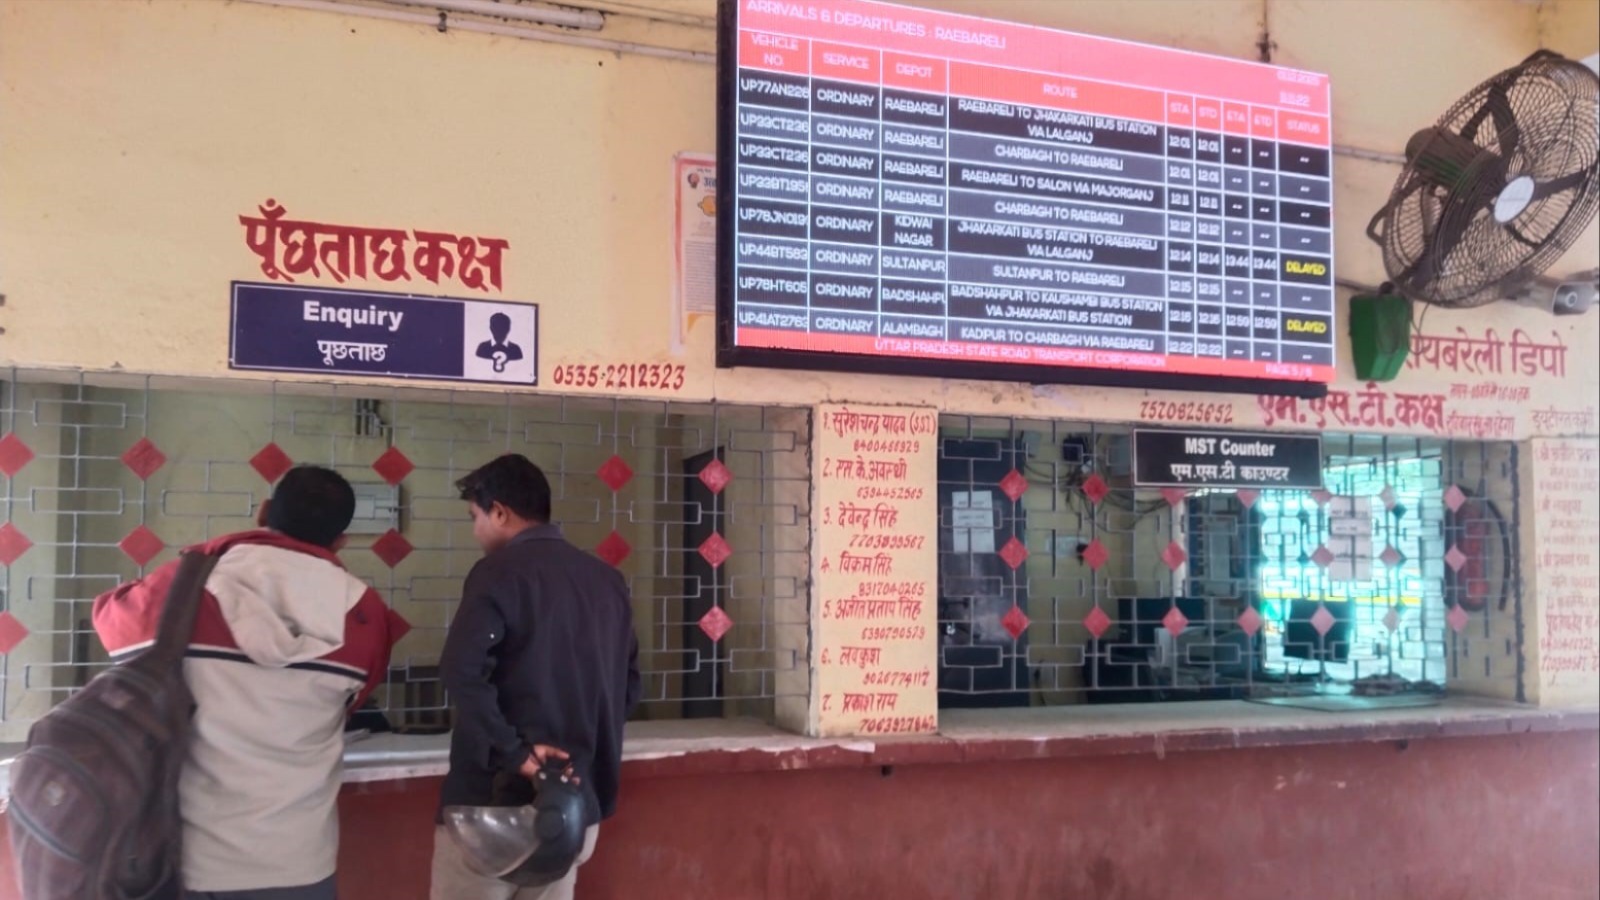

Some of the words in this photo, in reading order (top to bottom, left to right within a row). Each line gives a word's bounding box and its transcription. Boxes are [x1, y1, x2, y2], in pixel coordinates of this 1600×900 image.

[746, 0, 817, 21] ARRIVALS
[834, 11, 925, 37] DEPARTURES
[935, 27, 1006, 48] RAEBARELI
[751, 33, 798, 50] VEHICLE
[822, 53, 869, 69] SERVICE
[896, 62, 932, 78] DEPOT
[816, 88, 874, 107] ORDINARY
[1043, 83, 1078, 98] ROUTE
[885, 97, 944, 116] RAEBARELI
[1170, 102, 1190, 114] STA
[1199, 107, 1218, 118] STD
[958, 99, 1014, 118] RAEBARELI
[1017, 106, 1031, 119] TO
[1033, 110, 1093, 128] JHAKARKATI
[1095, 116, 1115, 130] BUS
[1117, 119, 1158, 135] STATION
[1227, 112, 1245, 123] ETA
[1254, 116, 1272, 127] ETD
[816, 122, 874, 141] ORDINARY
[1027, 125, 1044, 137] VIA
[1046, 127, 1094, 144] LALGANJ
[1287, 119, 1320, 134] STATUS
[885, 130, 943, 149] RAEBARELI
[816, 153, 874, 171] ORDINARY
[995, 145, 1052, 163] CHARBAGH
[1054, 152, 1069, 165] TO
[1070, 155, 1123, 171] RAEBARELI
[885, 161, 943, 179] RAEBARELI
[816, 183, 873, 199] ORDINARY
[961, 169, 1018, 186] RAEBARELI
[1020, 176, 1035, 188] TO
[1037, 178, 1074, 193] SALON
[1073, 182, 1089, 194] VIA
[1091, 184, 1154, 202] MAJORGANJ
[884, 189, 943, 207] RAEBARELI
[894, 215, 933, 228] KIDWAI
[994, 201, 1052, 218] CHARBAGH
[1054, 207, 1069, 220] TO
[1070, 209, 1124, 225] RAEBARELI
[816, 216, 873, 232] ORDINARY
[894, 232, 934, 246] NAGAR
[958, 221, 1020, 238] JHAKARKATI
[1022, 227, 1044, 240] BUS
[1045, 230, 1087, 243] STATION
[1088, 234, 1103, 245] TO
[1104, 235, 1158, 250] RAEBARELI
[413, 229, 510, 293] कक्ष
[816, 250, 873, 266] ORDINARY
[1027, 244, 1044, 257] VIA
[1045, 246, 1094, 261] LALGANJ
[882, 256, 946, 271] SULTANPUR
[1286, 260, 1326, 276] DELAYED
[993, 266, 1053, 281] SULTANPUR
[1054, 269, 1070, 283] TO
[1071, 272, 1125, 288] RAEBARELI
[815, 283, 873, 299] ORDINARY
[951, 284, 1023, 302] BADSHAHPUR
[1025, 290, 1040, 303] TO
[1041, 292, 1099, 307] KAUSHAMBI
[1100, 296, 1120, 309] BUS
[1122, 299, 1163, 312] STATION
[303, 300, 404, 331] Enquiry
[986, 305, 1003, 317] VIA
[1005, 307, 1066, 321] JHAKARKATI
[1068, 311, 1089, 323] BUS
[1090, 312, 1133, 326] STATION
[815, 317, 873, 333] ORDINARY
[882, 323, 943, 336] ALAMBAGH
[1286, 319, 1327, 334] DELAYED
[961, 327, 1005, 341] KADIPUR
[1008, 329, 1023, 342] TO
[1025, 331, 1082, 346] CHARBAGH
[1083, 335, 1100, 347] VIA
[1101, 337, 1154, 351] RAEBARELI
[317, 339, 388, 366] पूछताछ
[875, 340, 910, 353] UTTAR
[912, 342, 963, 357] PRADESH
[966, 345, 997, 357] STATE
[1001, 347, 1031, 359] ROAD
[1033, 349, 1094, 363] TRANSPORT
[1095, 352, 1165, 367] CORPORATION
[1511, 331, 1568, 378] डिपो
[1265, 364, 1290, 375] PAGE
[1185, 437, 1217, 455] MST
[1220, 438, 1276, 456] Counter
